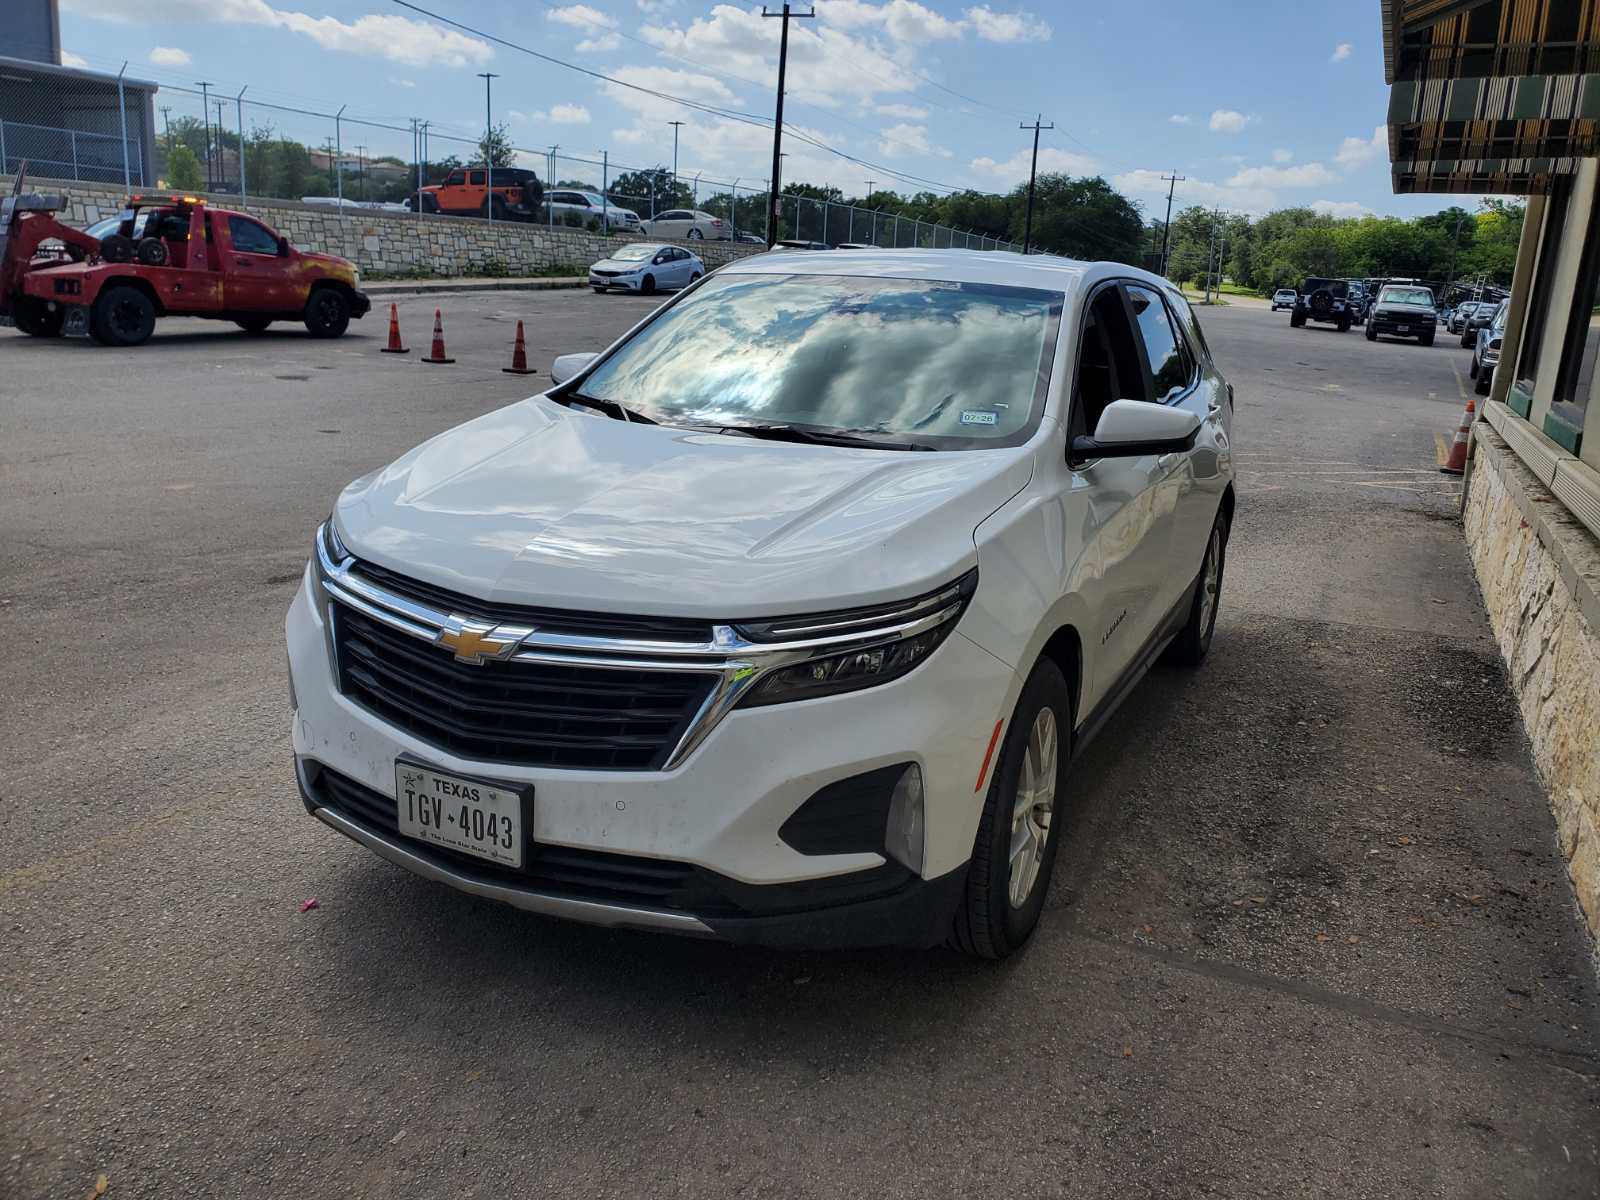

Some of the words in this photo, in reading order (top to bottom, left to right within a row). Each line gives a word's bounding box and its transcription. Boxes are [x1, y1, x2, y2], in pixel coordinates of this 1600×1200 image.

[432, 778, 480, 802] TEXAS
[405, 789, 441, 829] TGV
[460, 805, 513, 849] 4043
